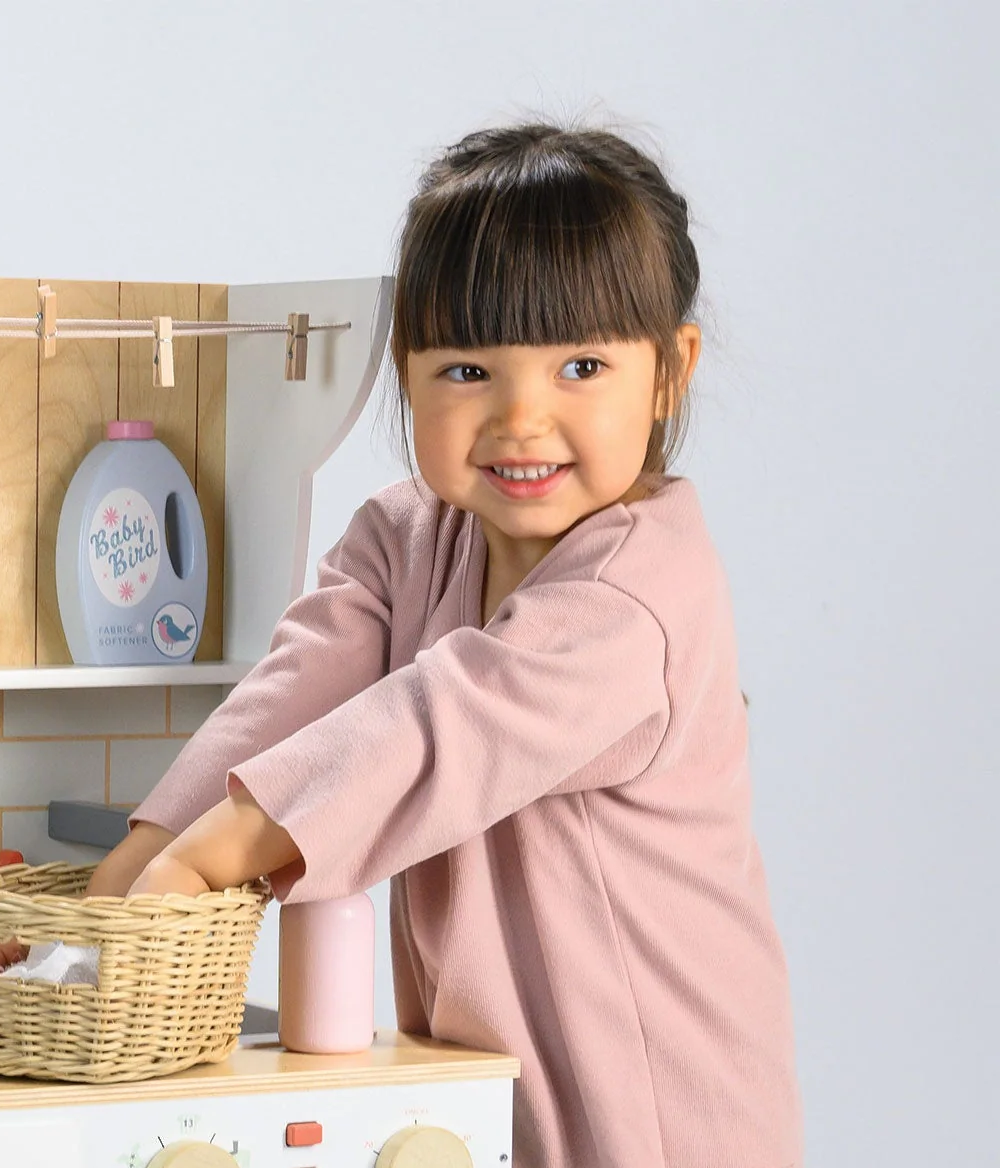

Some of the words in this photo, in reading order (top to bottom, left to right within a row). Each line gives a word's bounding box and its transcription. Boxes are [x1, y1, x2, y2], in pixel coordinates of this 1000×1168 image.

[90, 513, 146, 559] Baby
[108, 529, 158, 579] Bird
[99, 624, 133, 634] FABRIC
[99, 636, 148, 647] SOFTENER
